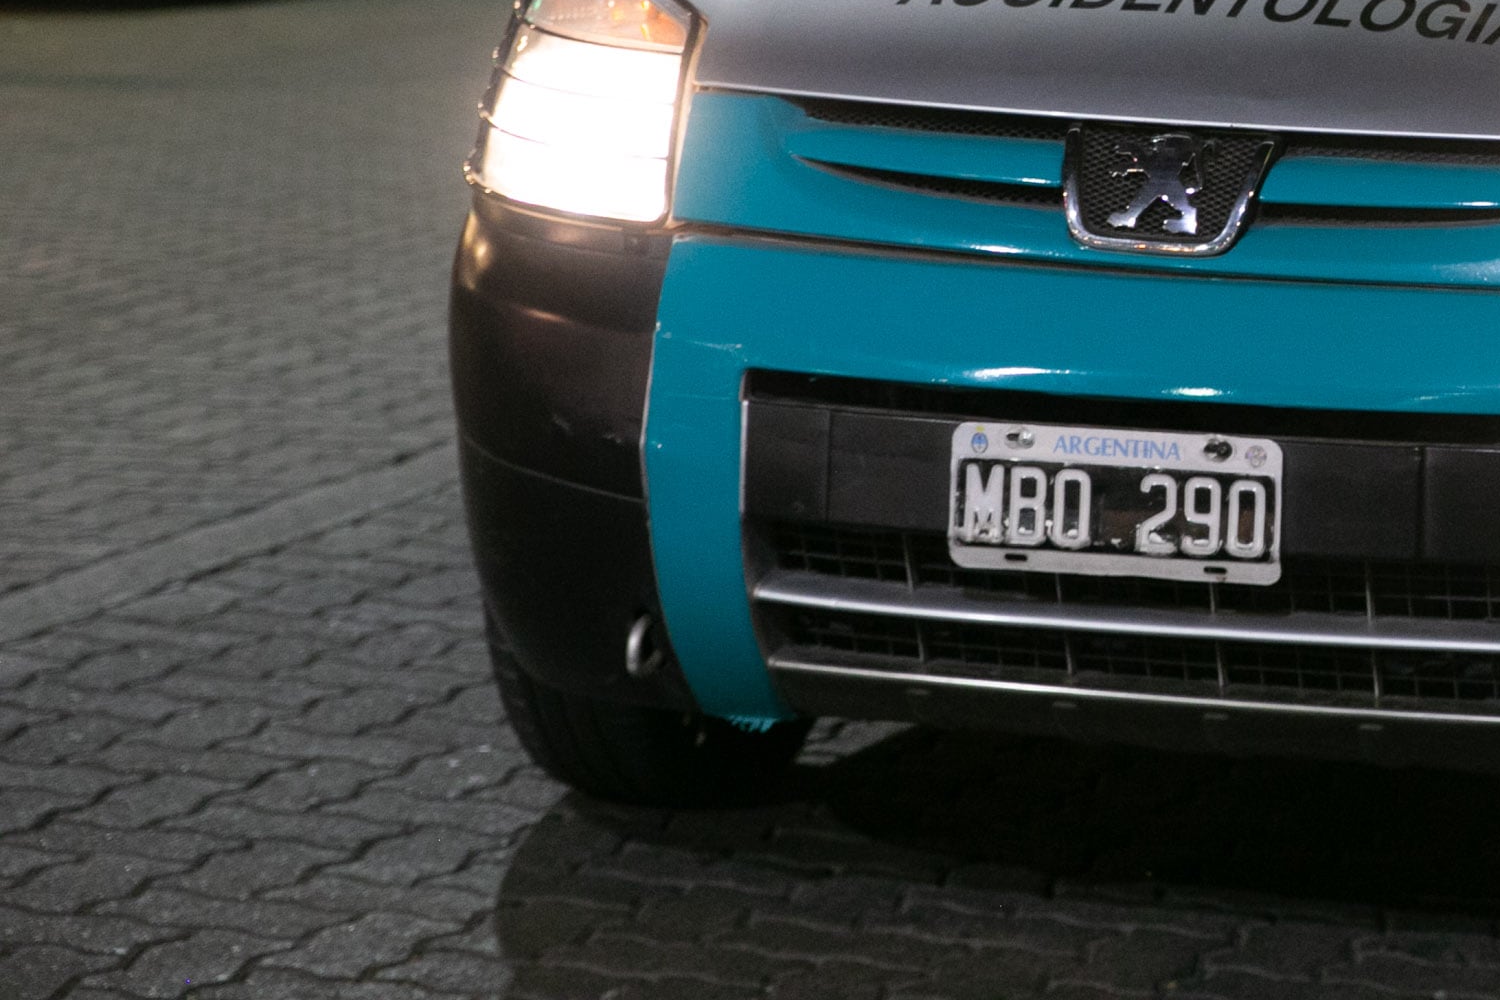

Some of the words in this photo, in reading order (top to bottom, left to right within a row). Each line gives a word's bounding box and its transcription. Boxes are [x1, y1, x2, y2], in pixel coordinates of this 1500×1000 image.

[1052, 434, 1181, 461] ARGENTINA
[963, 463, 1091, 549] MBO
[1135, 472, 1265, 559] 290
